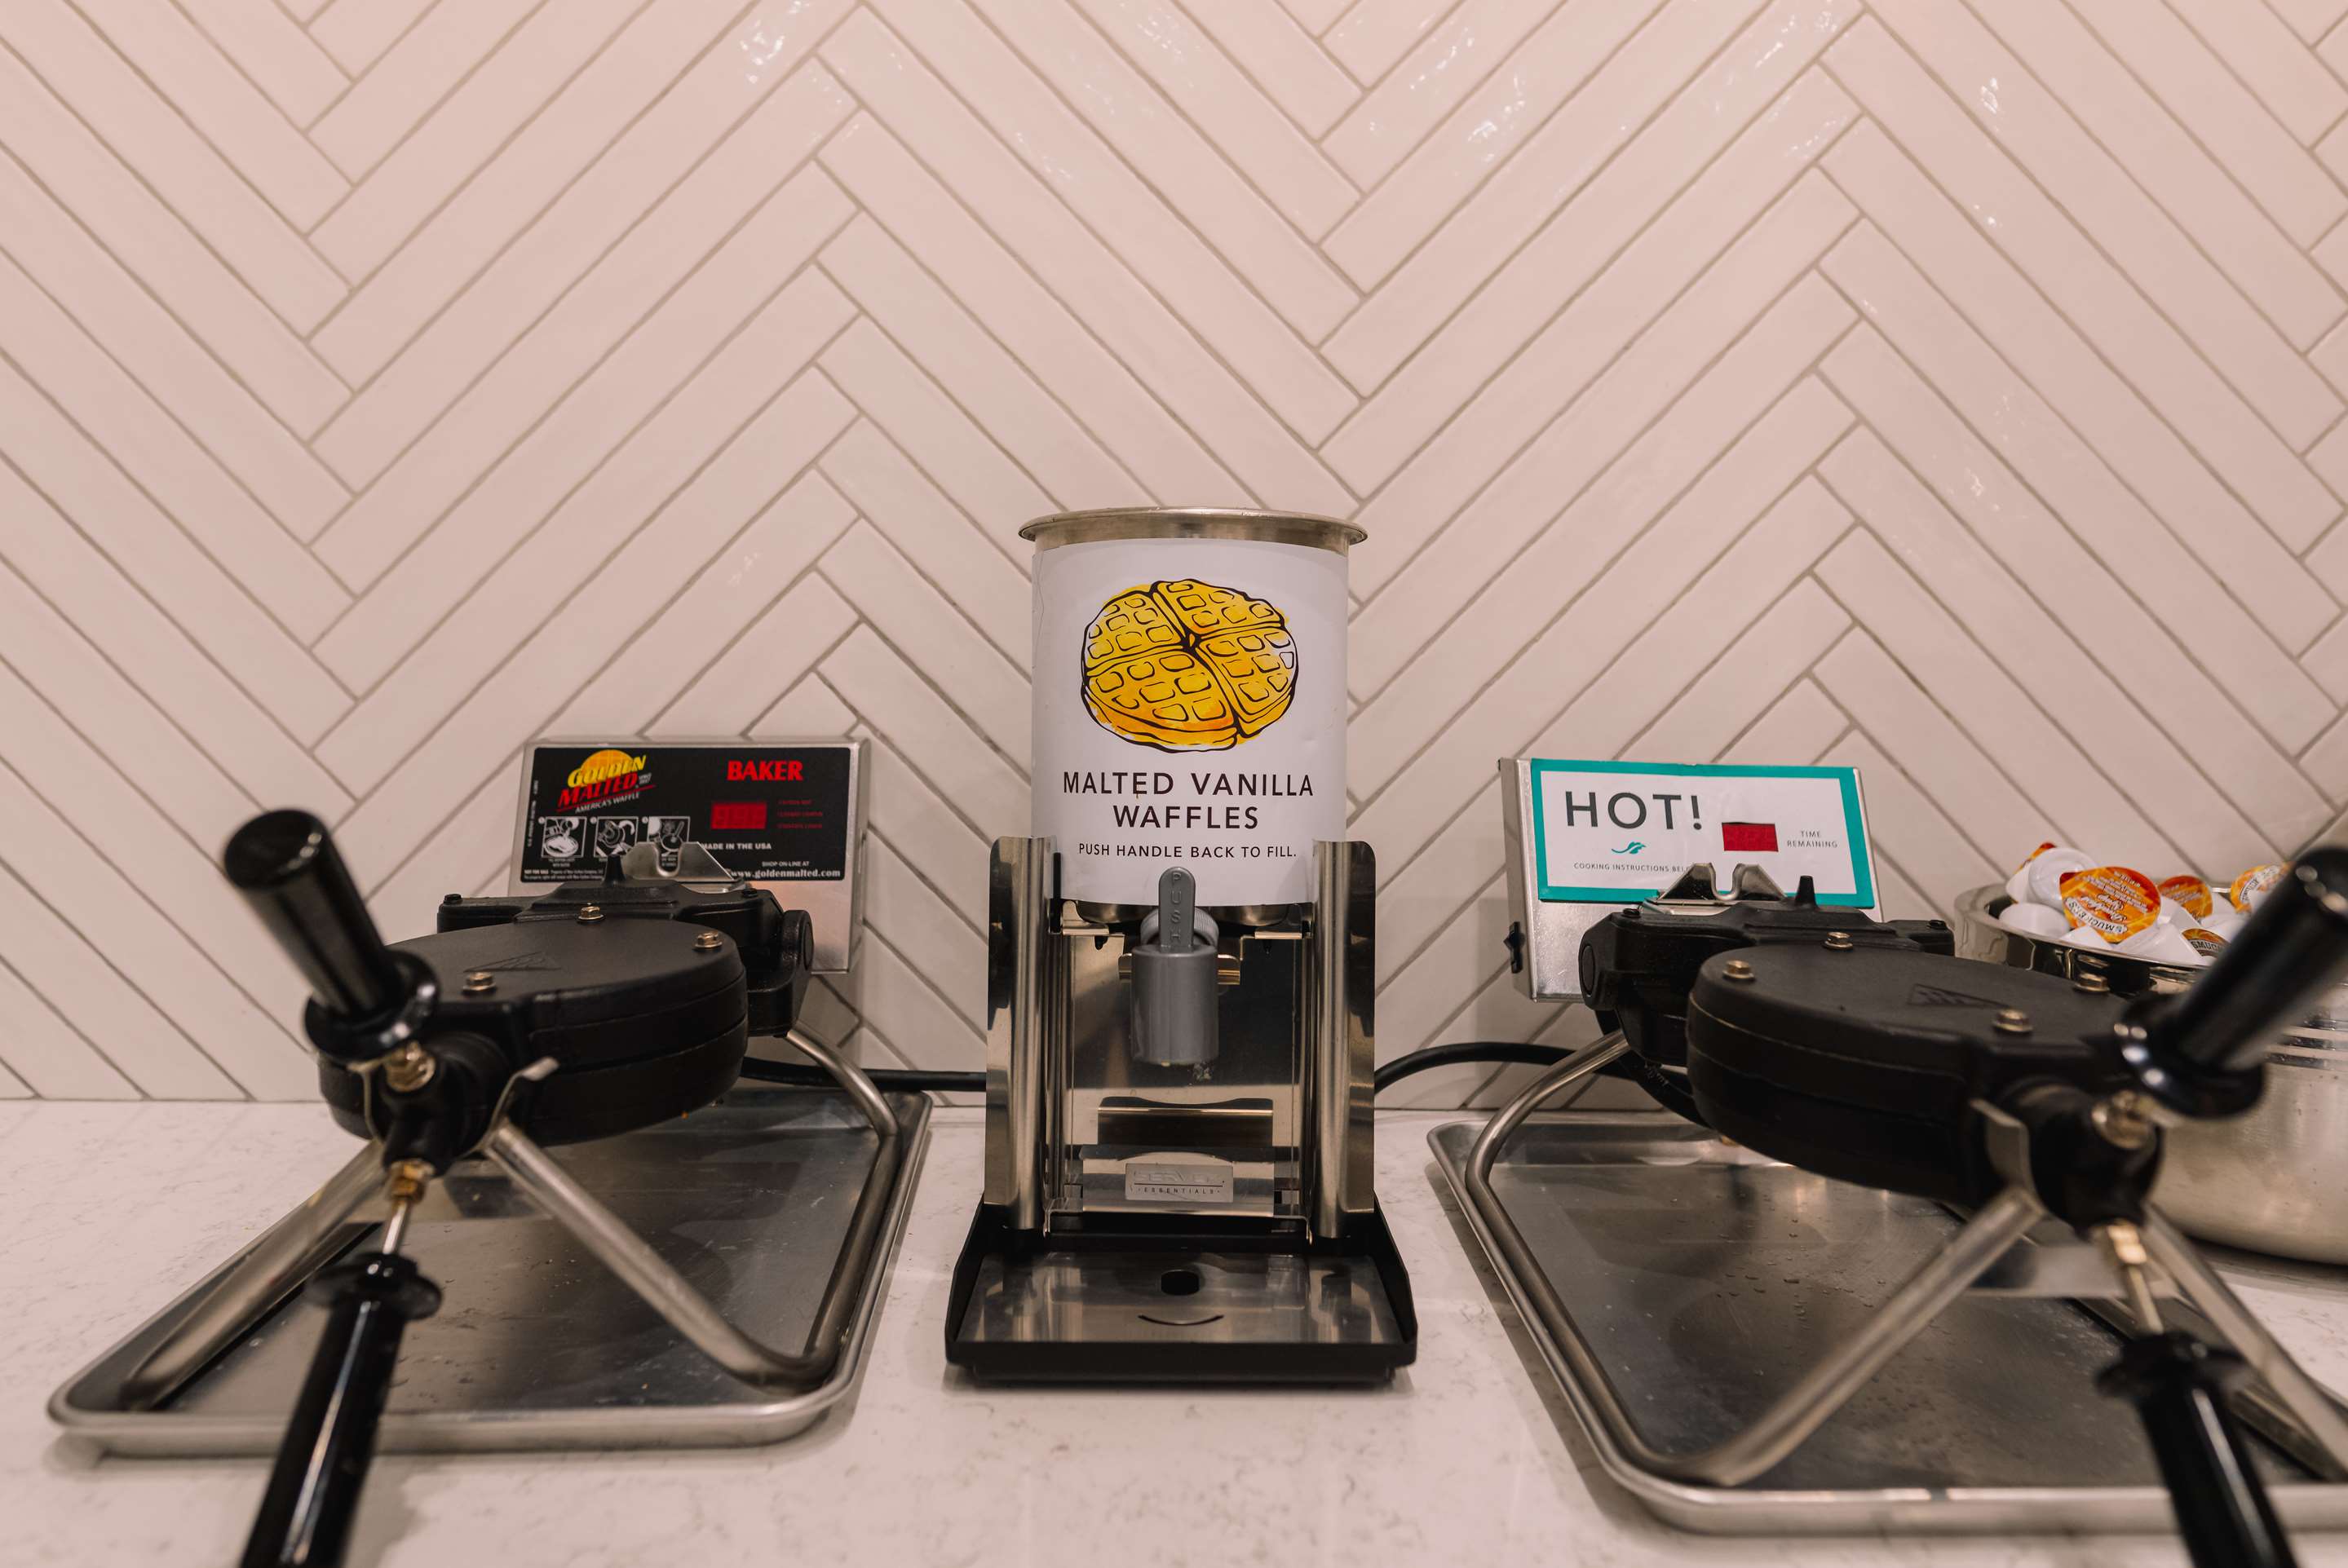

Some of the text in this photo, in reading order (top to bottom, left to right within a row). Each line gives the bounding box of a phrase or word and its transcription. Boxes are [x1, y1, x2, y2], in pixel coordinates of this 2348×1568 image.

[568, 755, 646, 788] GOLDEN
[727, 760, 804, 781] BAKER
[557, 771, 638, 807] MALTED
[1063, 771, 1314, 797] MALTED VANILLA
[575, 792, 640, 814] AMERICA'S WAFFLE
[1565, 791, 1702, 830] HOT!
[1112, 805, 1258, 829] WAFFLES
[1786, 840, 1838, 849] REMAINING
[1800, 830, 1821, 838] TIME
[1079, 843, 1297, 859] PUSH HANDLE BACK TO FILL.
[731, 868, 841, 879] www.goldenmalted.com
[1573, 863, 1610, 871] COOKING
[1612, 864, 1669, 872] INSTRUCTIONS
[1170, 871, 1182, 942] PUSH
